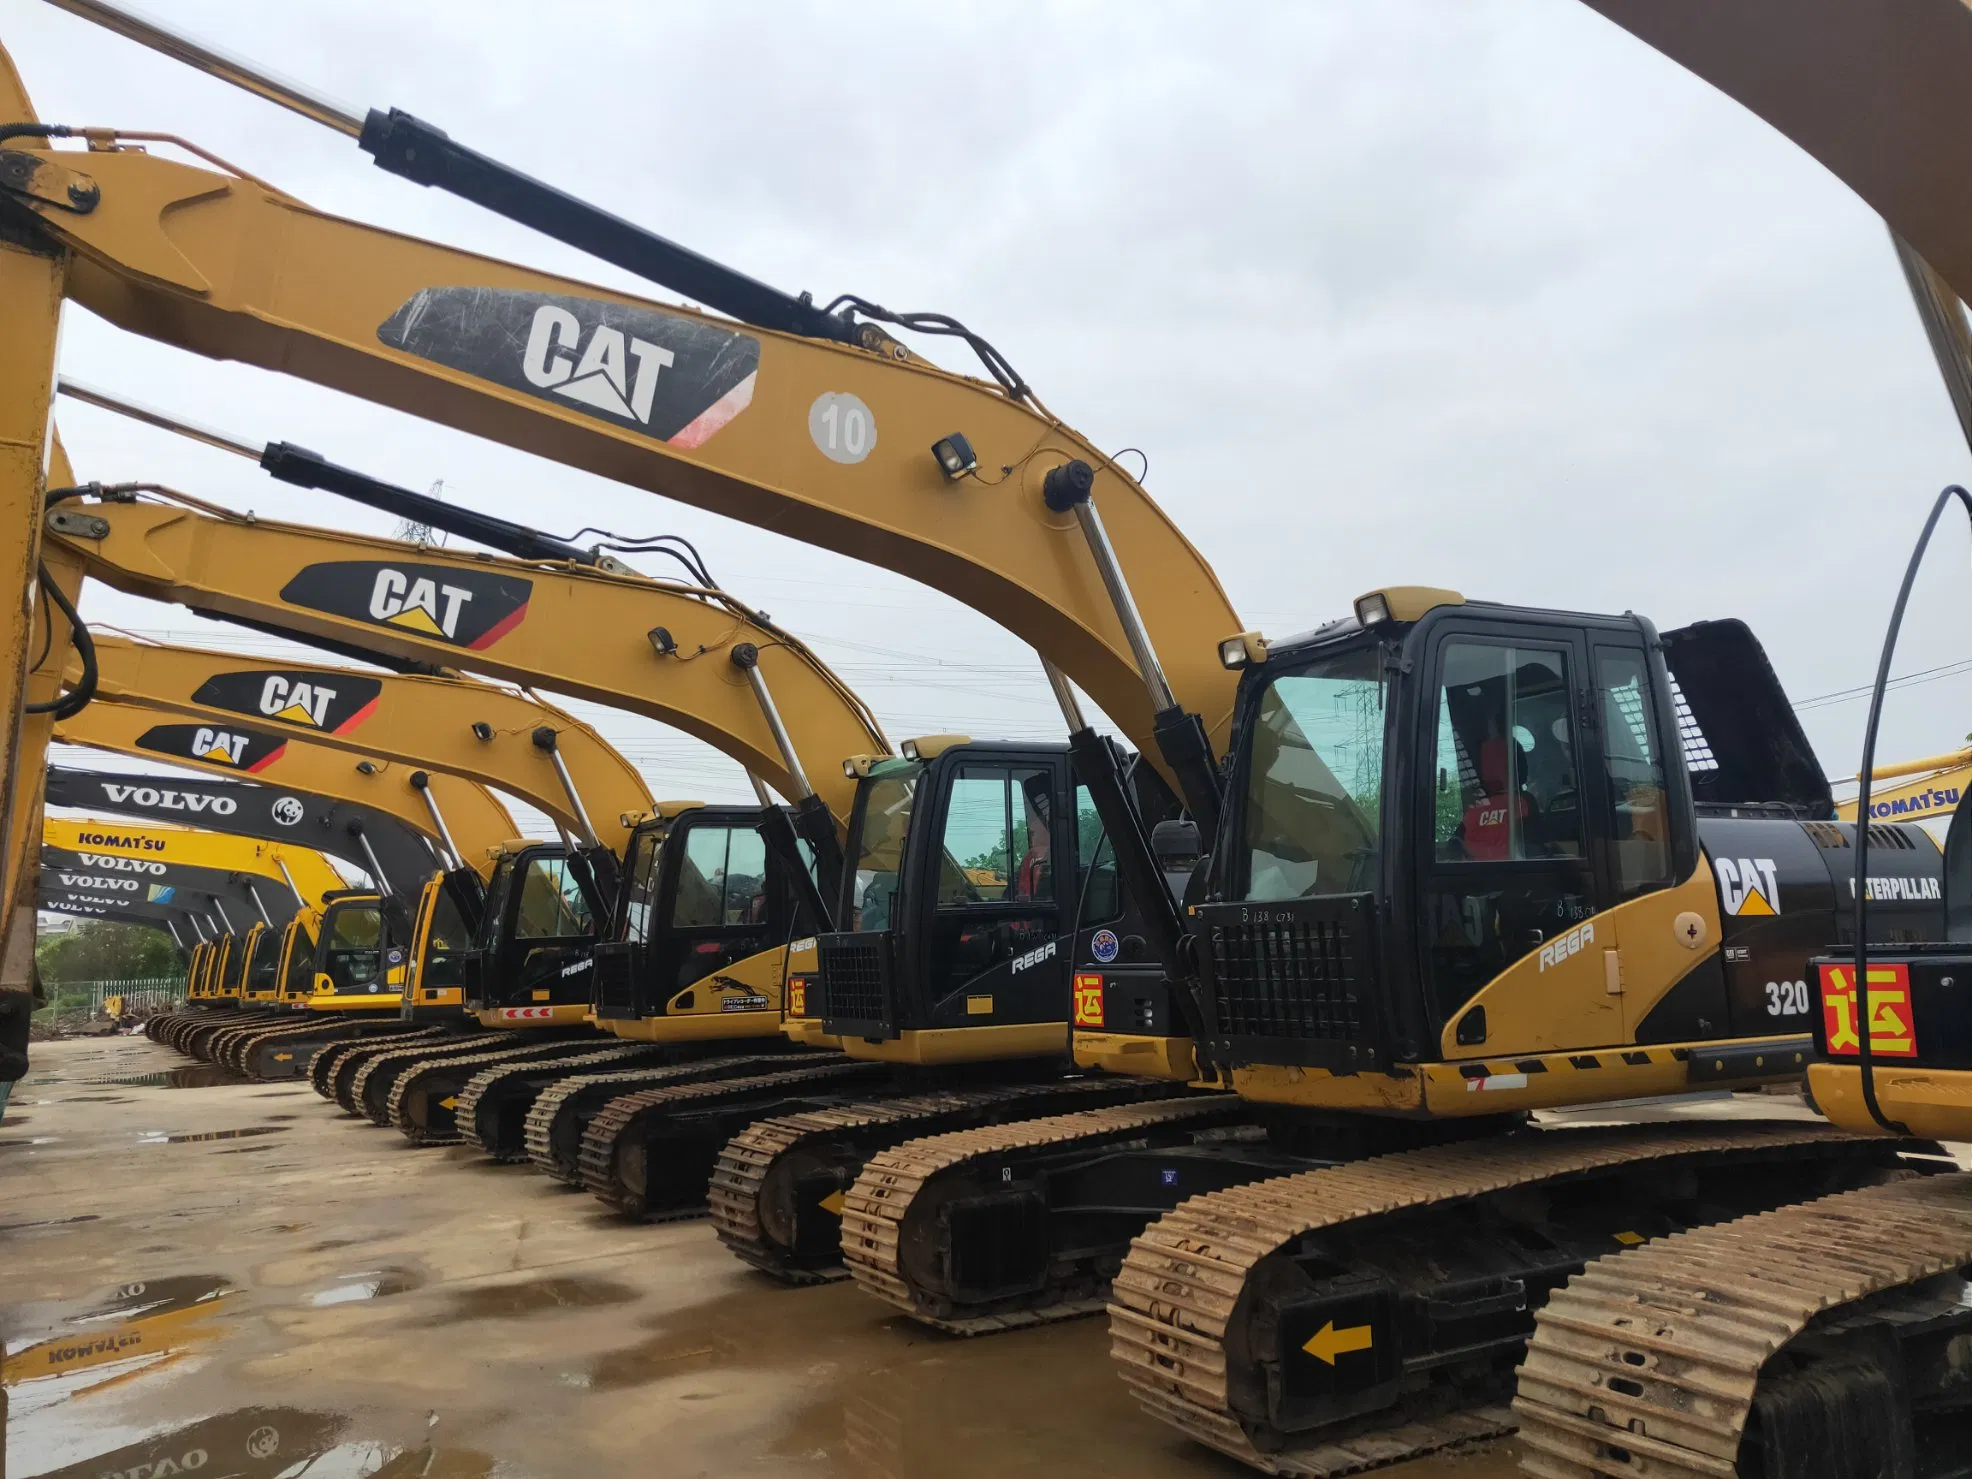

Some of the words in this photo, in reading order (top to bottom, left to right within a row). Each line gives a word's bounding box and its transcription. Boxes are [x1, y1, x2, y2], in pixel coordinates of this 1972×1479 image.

[523, 305, 674, 424] CAT
[821, 403, 867, 456] 10
[369, 568, 473, 639] CAT
[259, 675, 337, 727] CAT
[191, 727, 250, 765] CAT
[101, 783, 237, 815] VOLVO
[1479, 808, 1508, 827] CAT
[78, 832, 166, 852] KOMATSU
[59, 874, 140, 891] VOLVO
[78, 853, 167, 876] VOLVO
[1715, 857, 1781, 916] CAT
[789, 936, 818, 954] REG
[1011, 942, 1056, 975] REGA
[1539, 922, 1595, 973] REGA
[561, 959, 593, 978] REGA
[790, 979, 805, 1016] 运
[1074, 975, 1102, 1025] 运
[1765, 980, 1809, 1017] 320
[1825, 967, 1913, 1052] 运
